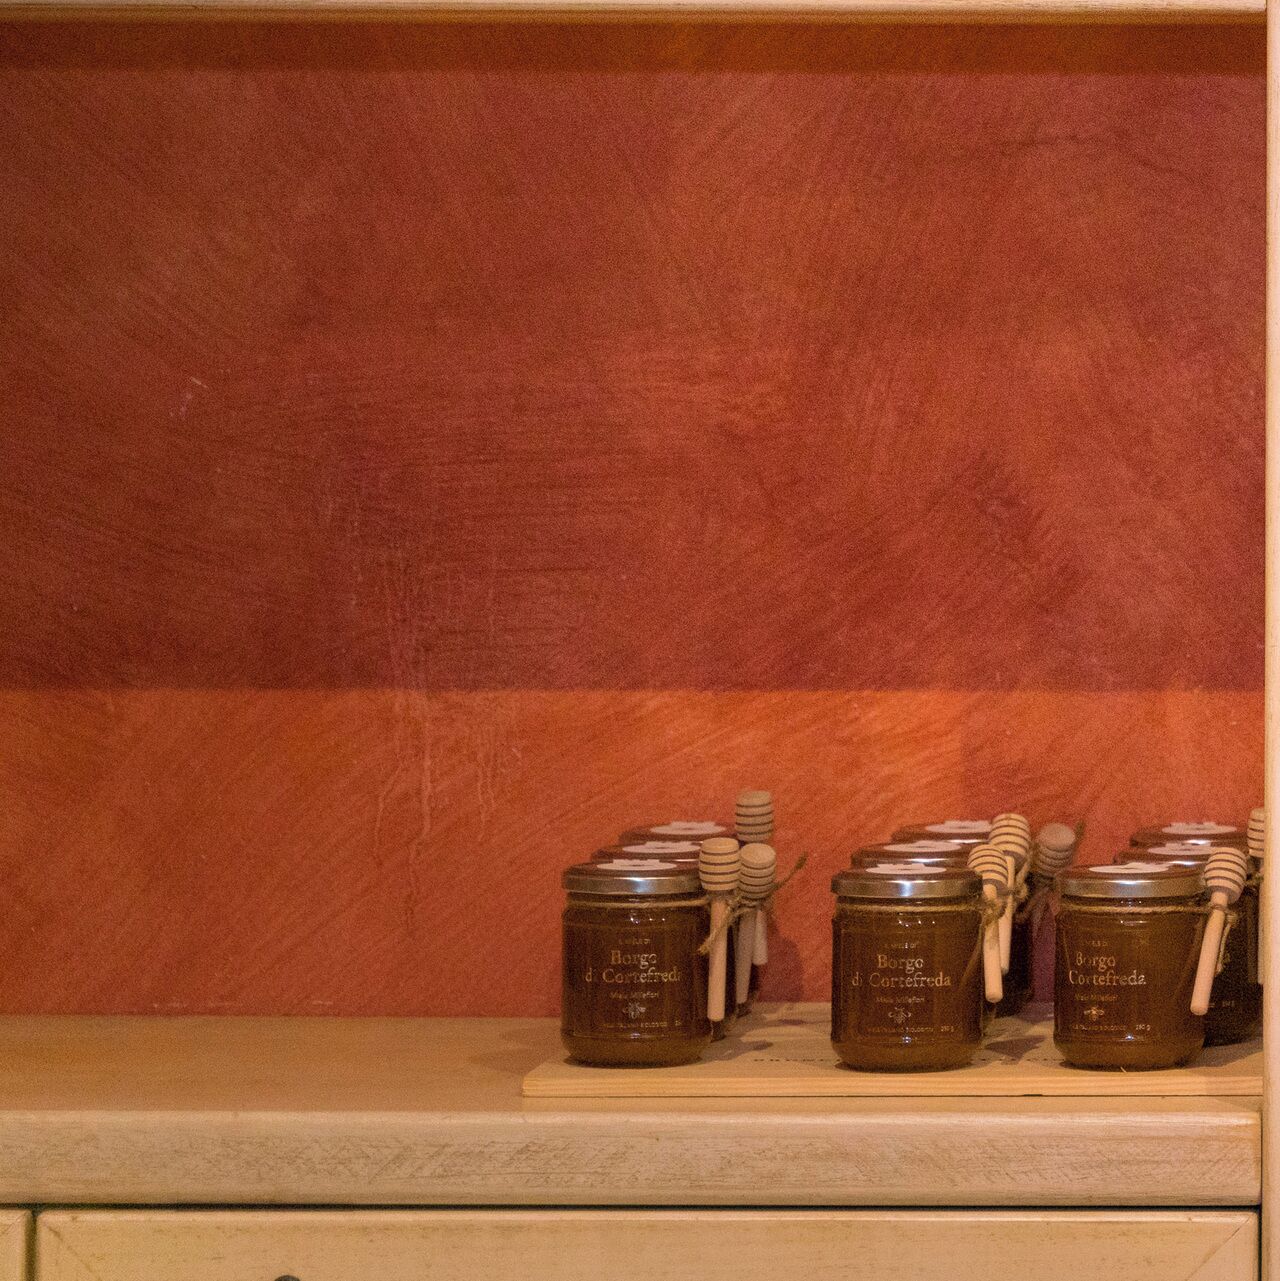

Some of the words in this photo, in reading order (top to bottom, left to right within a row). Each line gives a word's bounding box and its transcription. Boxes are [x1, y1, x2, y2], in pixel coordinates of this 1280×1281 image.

[611, 950, 657, 969] Borgo
[877, 954, 924, 974] Borgo
[1076, 952, 1116, 970] Borgo
[851, 971, 863, 987] di
[869, 972, 951, 987] Cortefreda
[1069, 970, 1147, 986] Cortefreda
